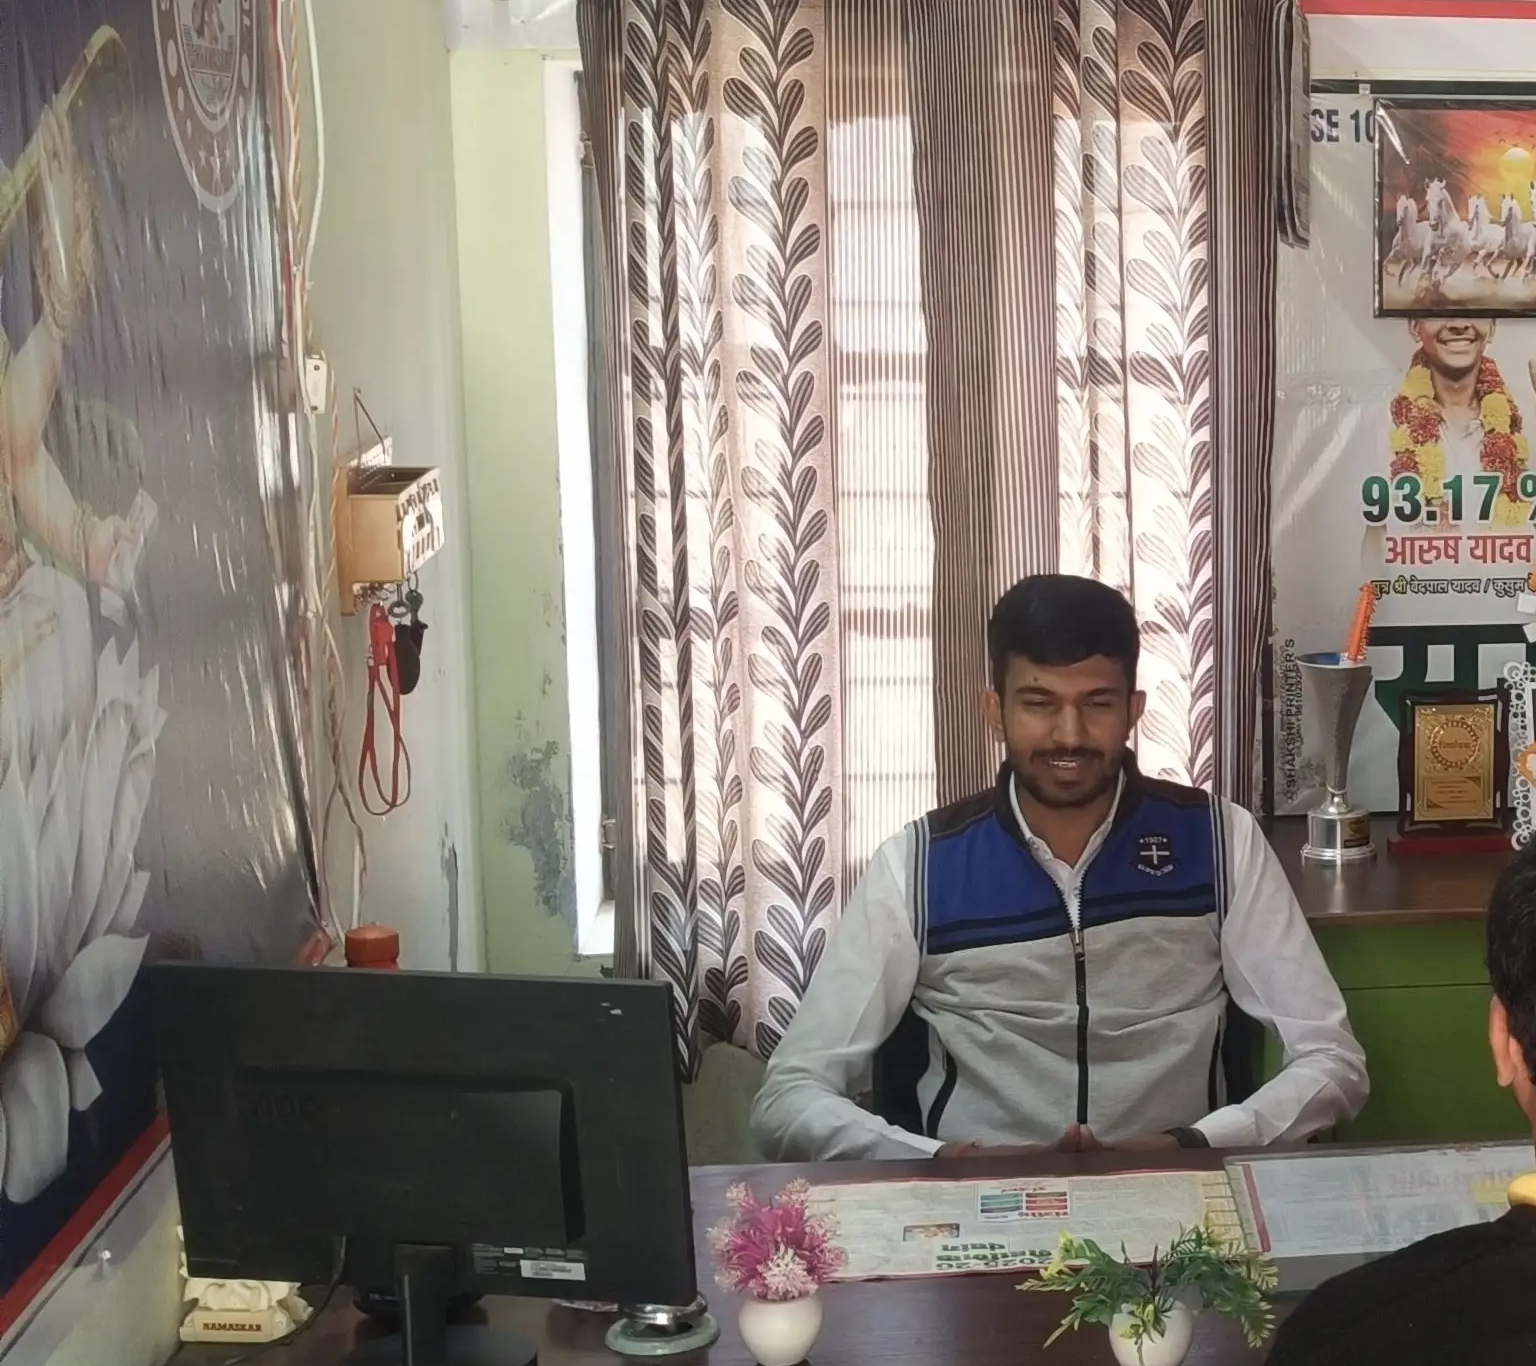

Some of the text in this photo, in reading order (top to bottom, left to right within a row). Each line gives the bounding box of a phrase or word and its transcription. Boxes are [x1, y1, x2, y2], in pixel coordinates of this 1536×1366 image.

[1362, 474, 1501, 524] 93.17
[1385, 534, 1535, 565] आरुष यादव
[1451, 578, 1481, 595] यादव
[1284, 638, 1297, 789] SHAKSHI PRINTER'S
[202, 1322, 264, 1333] NAMASKAR
